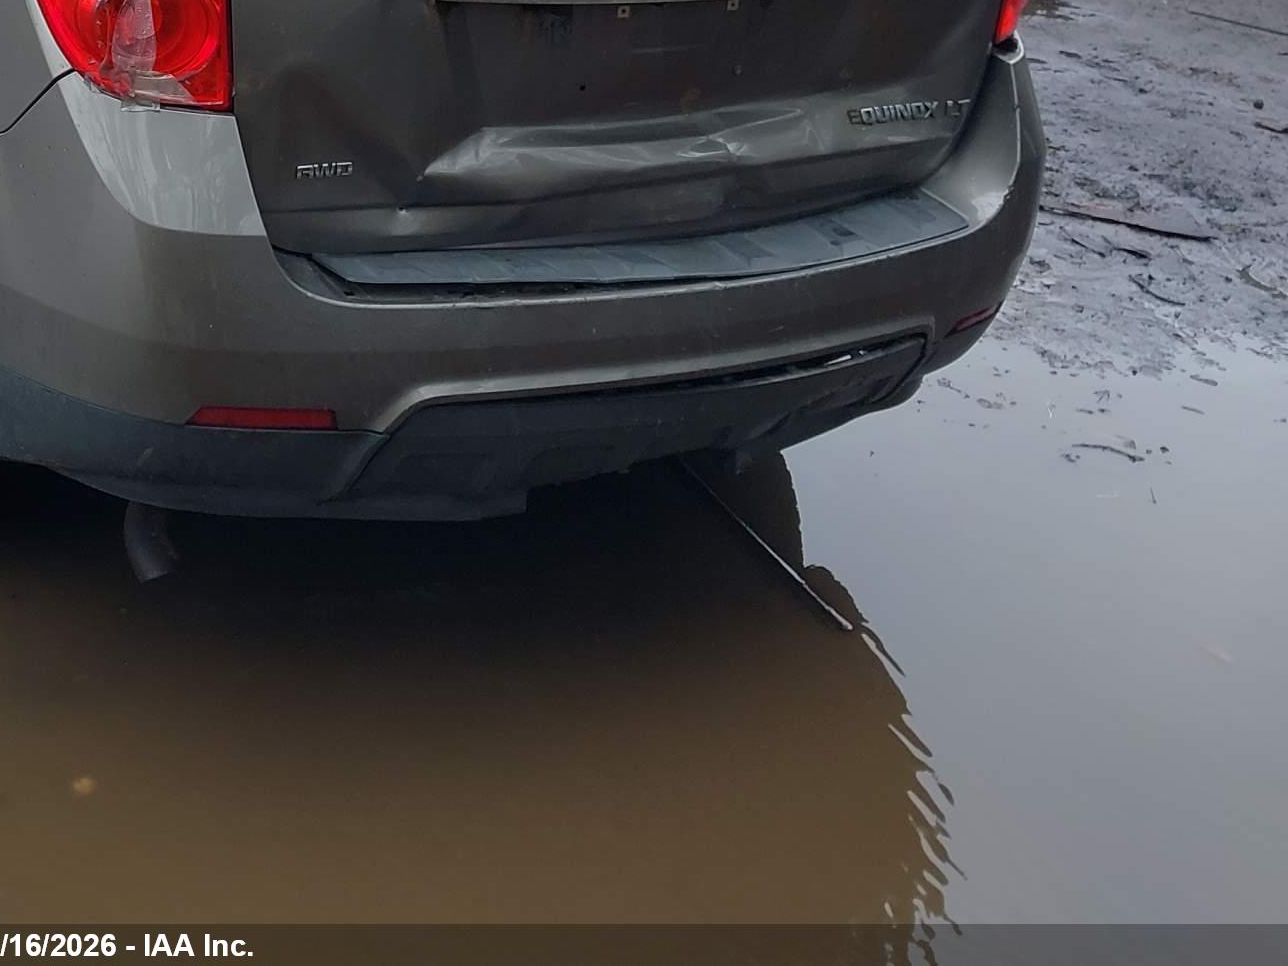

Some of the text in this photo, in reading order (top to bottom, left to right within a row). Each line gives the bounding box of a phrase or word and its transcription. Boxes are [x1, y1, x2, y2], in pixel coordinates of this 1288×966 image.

[847, 99, 971, 125] EQUINOX LT
[296, 162, 353, 179] AWD
